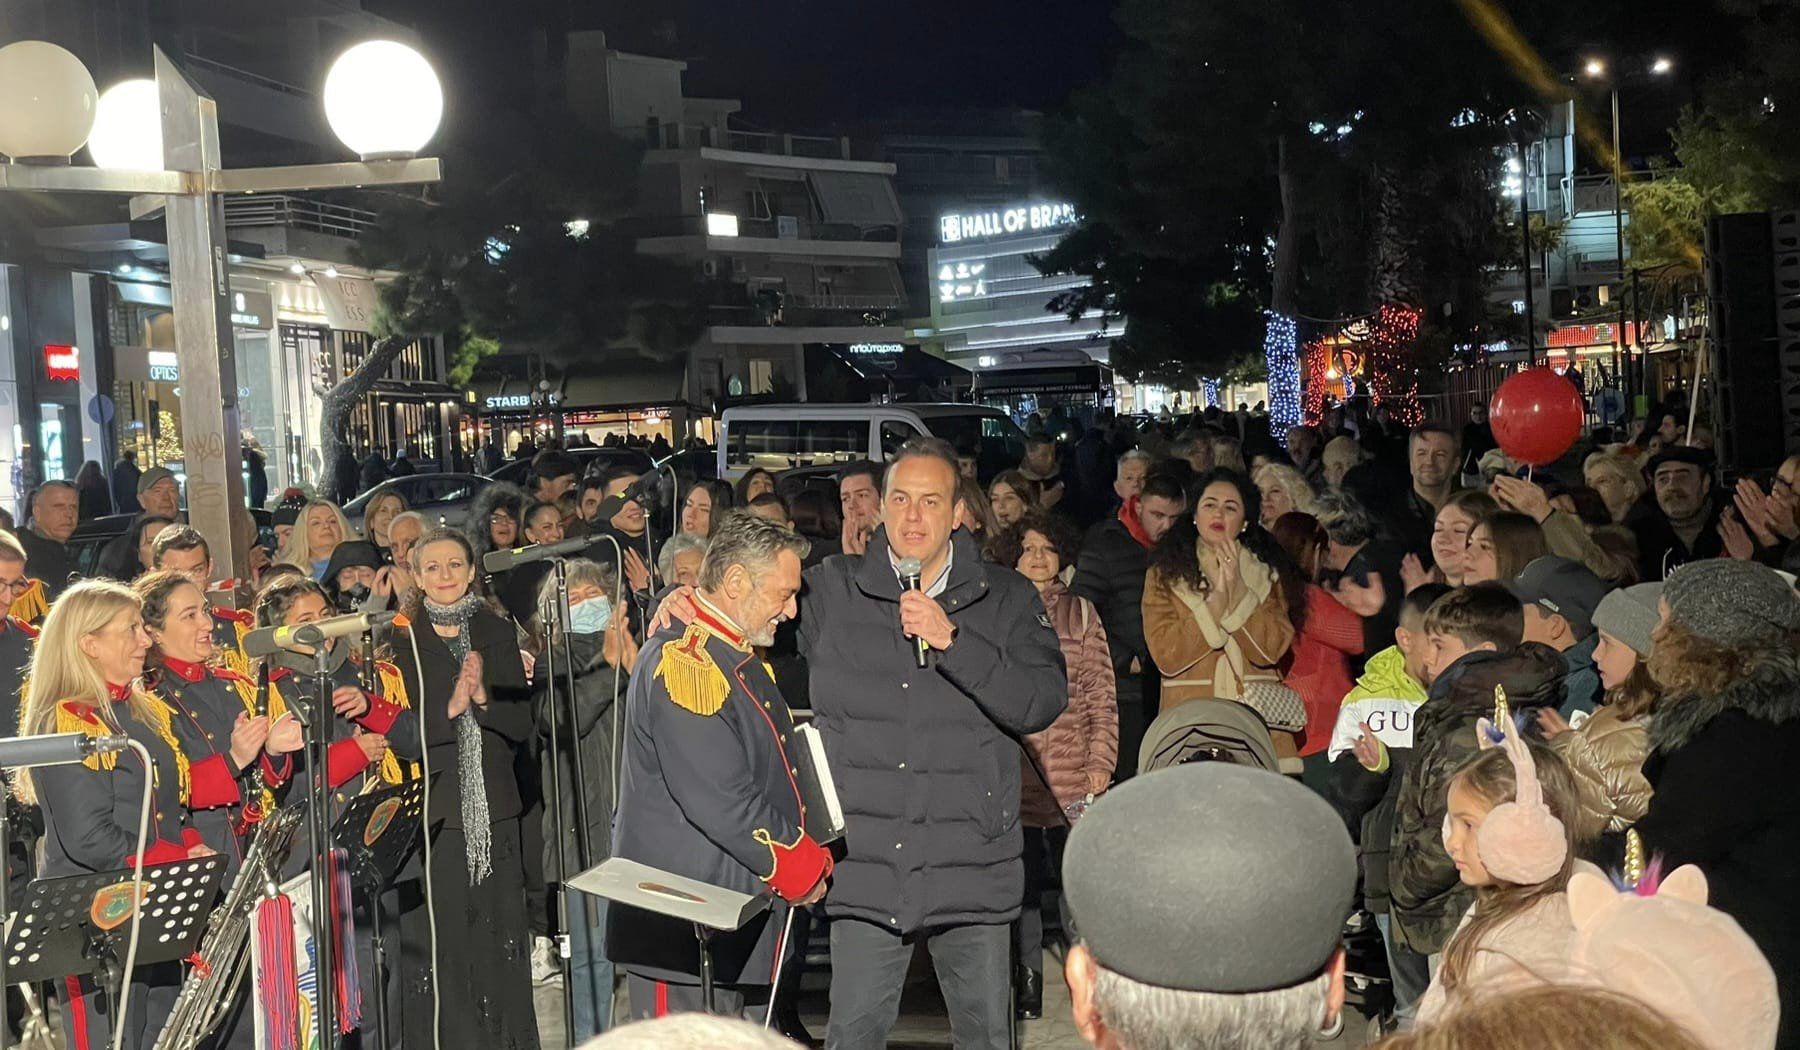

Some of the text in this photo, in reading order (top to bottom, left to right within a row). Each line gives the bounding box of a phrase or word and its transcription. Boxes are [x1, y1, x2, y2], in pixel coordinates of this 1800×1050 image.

[962, 203, 1080, 238] HALL OF BRAN
[150, 366, 178, 381] OPTICS
